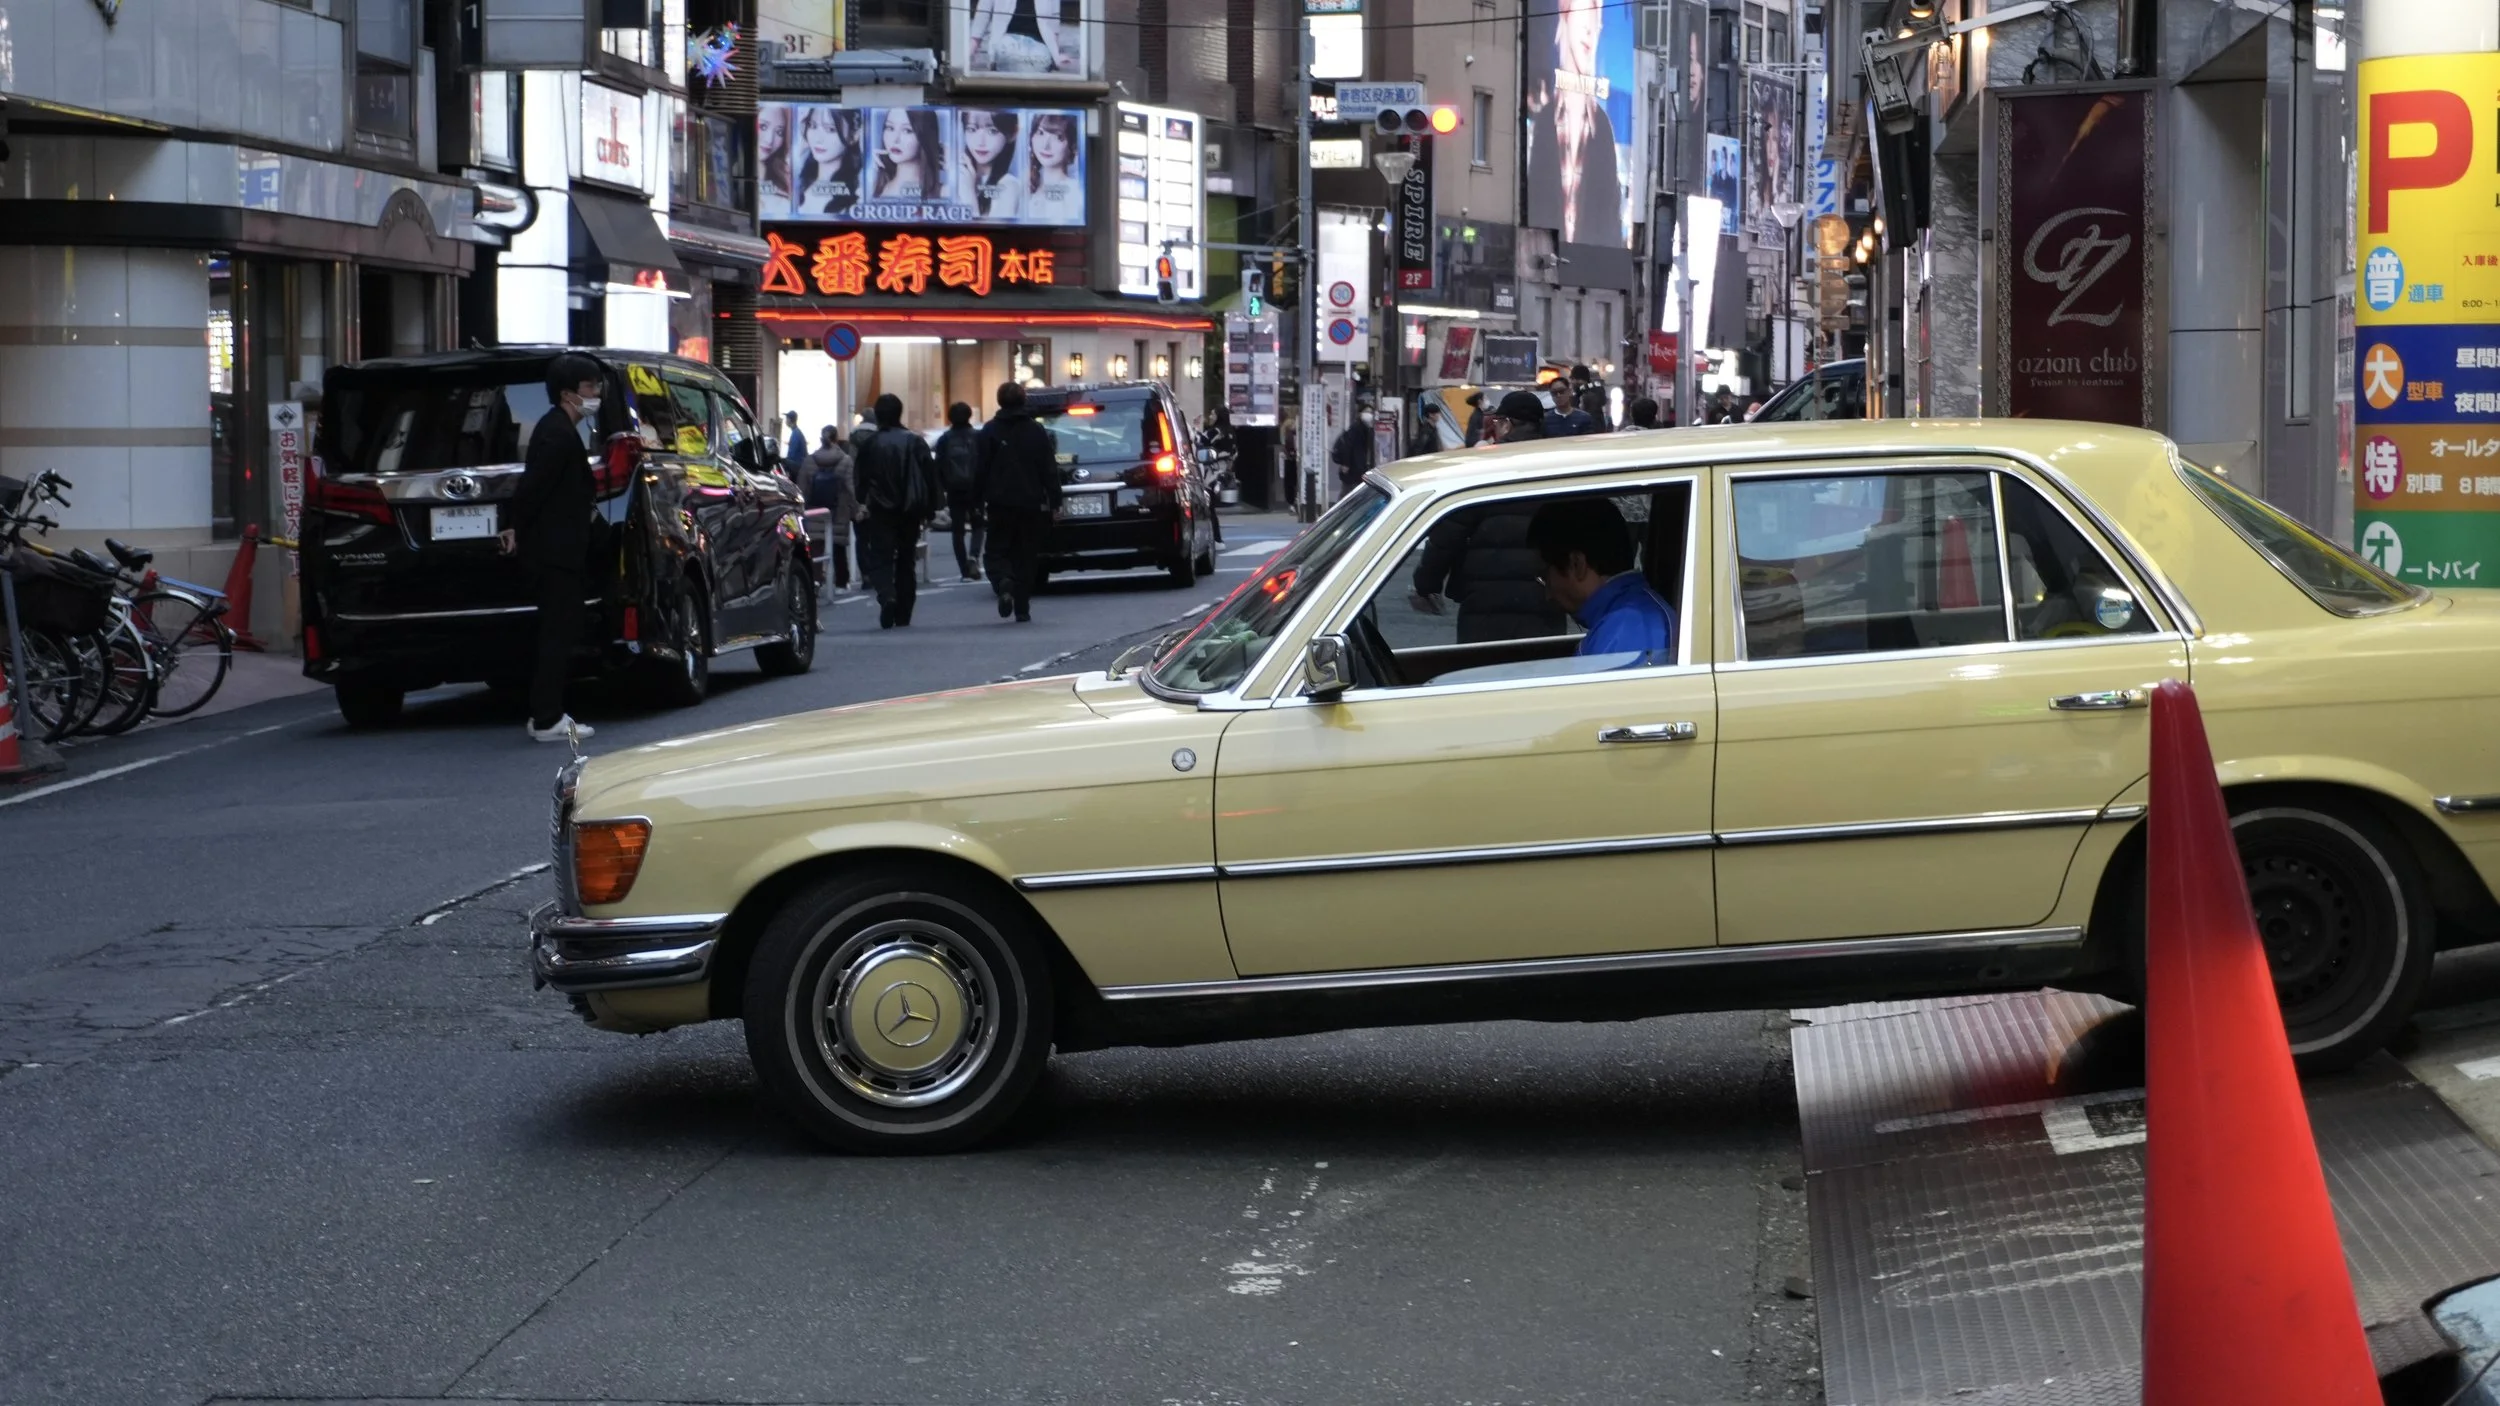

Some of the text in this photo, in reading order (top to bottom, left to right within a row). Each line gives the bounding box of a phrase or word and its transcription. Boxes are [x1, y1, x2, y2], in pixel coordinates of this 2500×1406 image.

[784, 34, 813, 54] 3F
[1340, 87, 1416, 103] 新宿区役所通り
[2368, 89, 2474, 234] P
[850, 204, 972, 221] GROUP RACE
[1404, 168, 1425, 261] SPIRE
[1000, 248, 1055, 284] 本店
[1405, 273, 1422, 285] 2F
[2018, 347, 2137, 374] azian club
[2456, 348, 2500, 368] 昼間
[2455, 393, 2500, 413] 夜間
